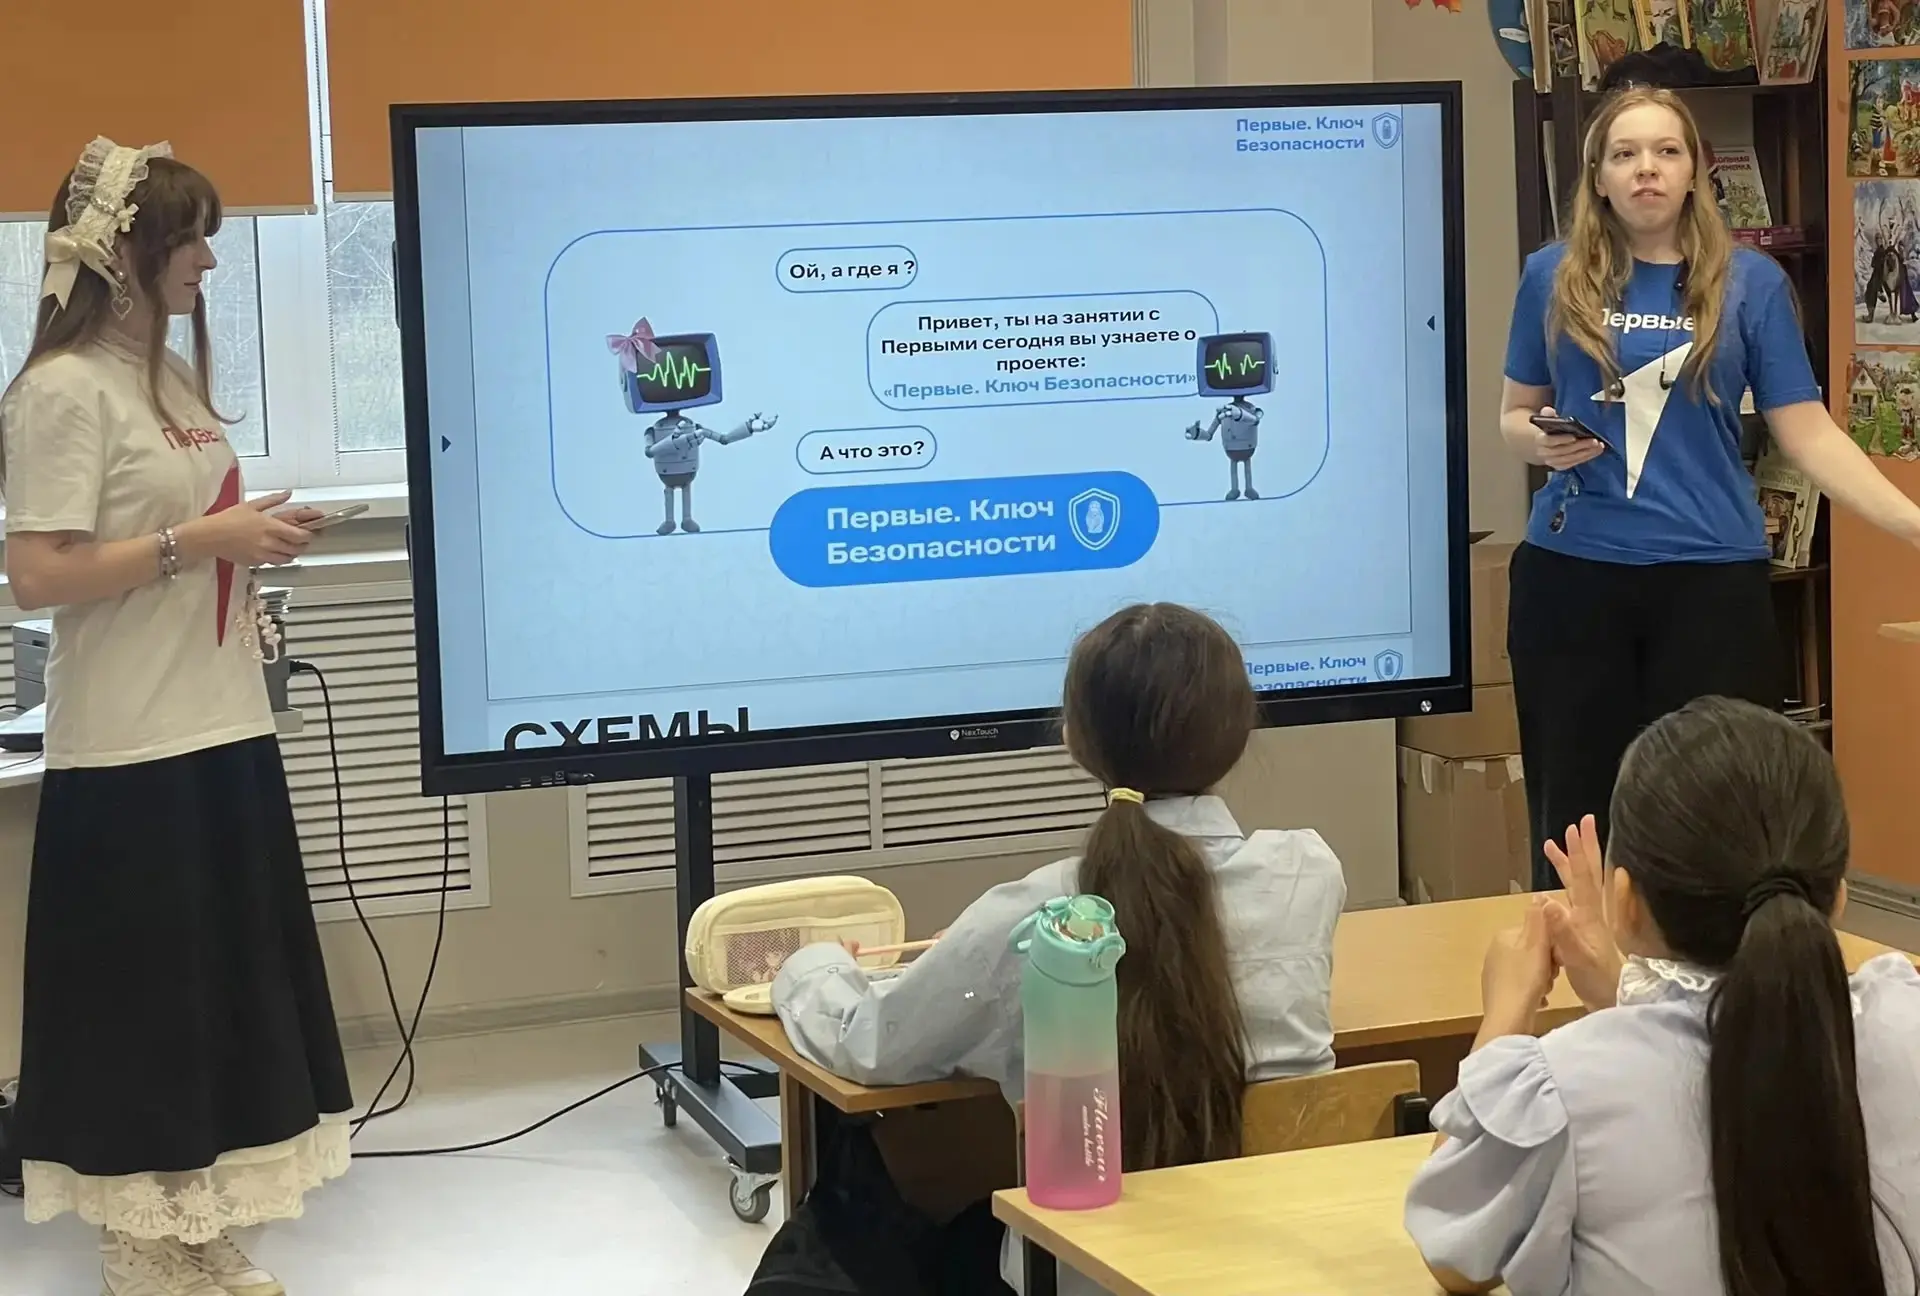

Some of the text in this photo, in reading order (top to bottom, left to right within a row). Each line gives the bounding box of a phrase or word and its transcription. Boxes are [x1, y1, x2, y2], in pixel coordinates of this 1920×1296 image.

[1236, 116, 1364, 134] Первые. Ключ
[1236, 137, 1365, 152] Безопасности
[789, 263, 825, 280] Ой,
[831, 266, 843, 278] а
[848, 264, 882, 279] где
[887, 264, 899, 275] я
[918, 309, 1160, 333] Привет, ты на занятии с
[881, 329, 1196, 356] Первыми сегодня вы узнаете о
[996, 356, 1086, 373] проекте:
[884, 373, 1196, 400] «Первые. Ключ Безопасности»
[819, 440, 925, 460] А что это?
[827, 499, 1054, 533] Первые. Ключ
[827, 534, 1056, 565] Безопасности
[1319, 656, 1367, 669] Ключ
[1093, 1087, 1108, 1182] Flavour
